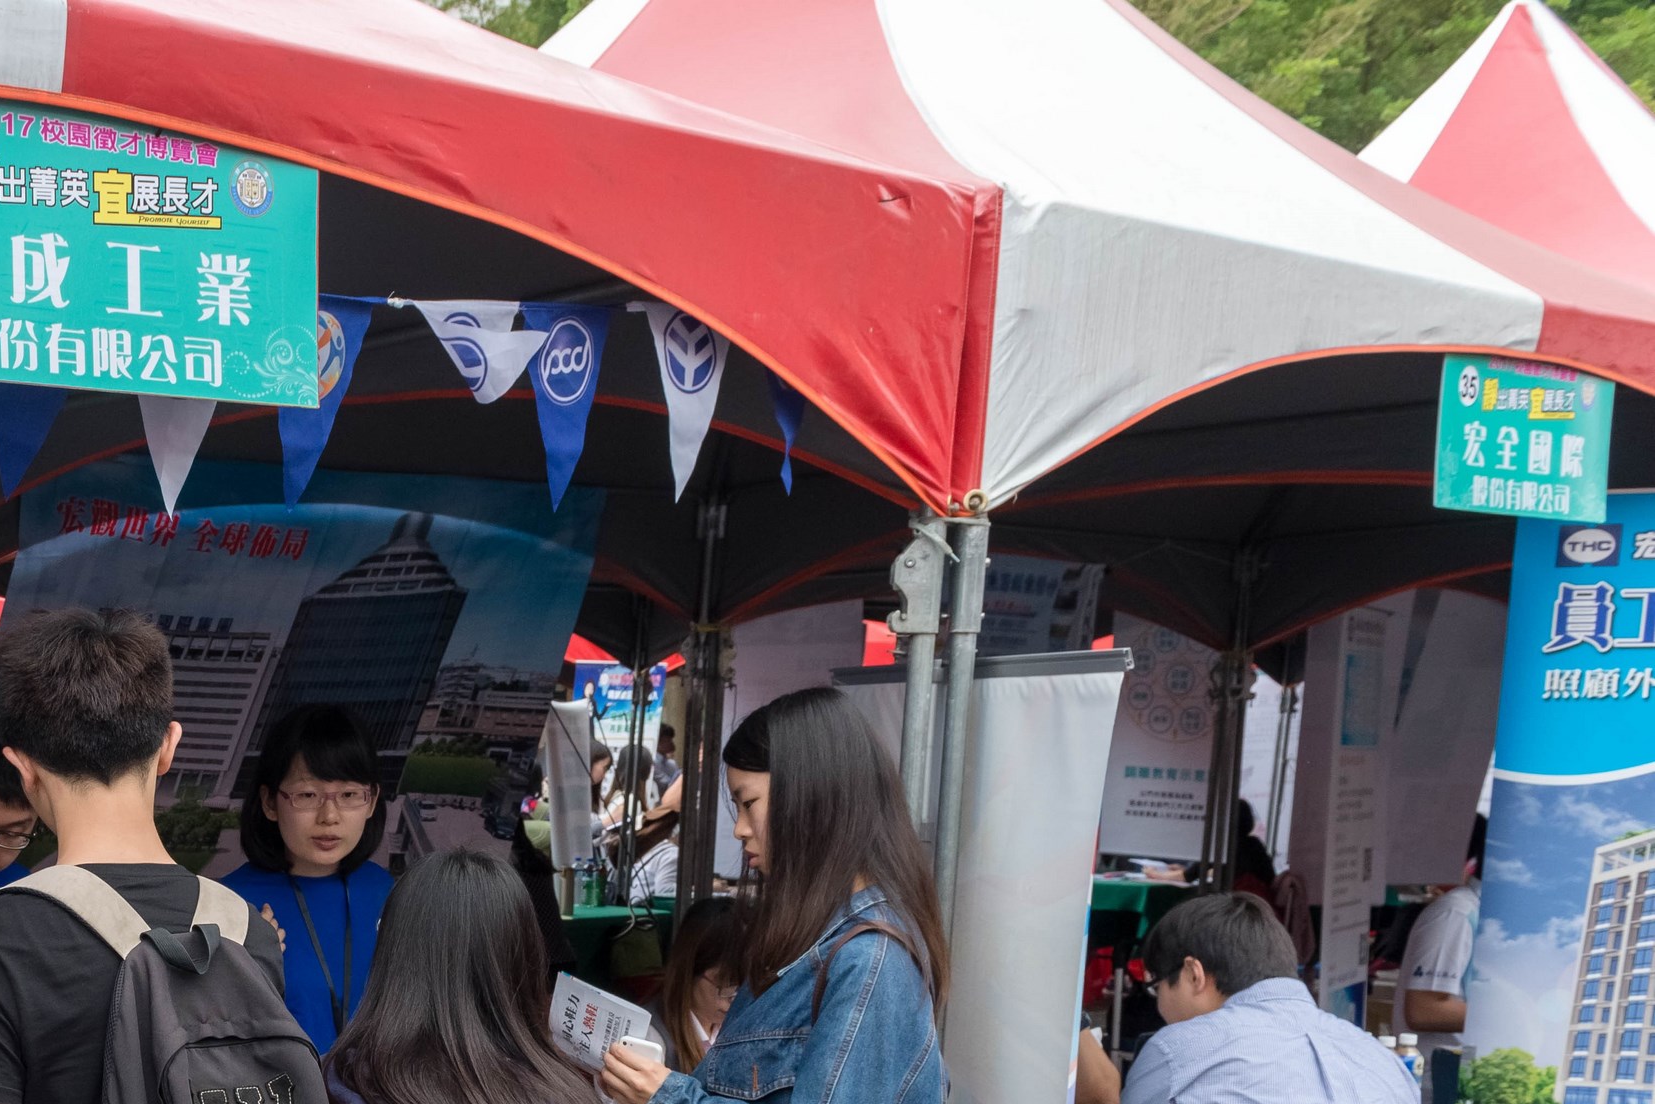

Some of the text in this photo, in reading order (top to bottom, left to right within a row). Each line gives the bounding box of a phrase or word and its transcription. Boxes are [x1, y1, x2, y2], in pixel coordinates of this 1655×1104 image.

[40, 117, 219, 168] 校園徵才博覽會
[1461, 374, 1477, 399] 35
[1462, 421, 1585, 478] 宏全國際
[1471, 475, 1570, 515] 股份有限公司
[188, 519, 309, 560] 全球佈局
[1568, 540, 1612, 553] THC
